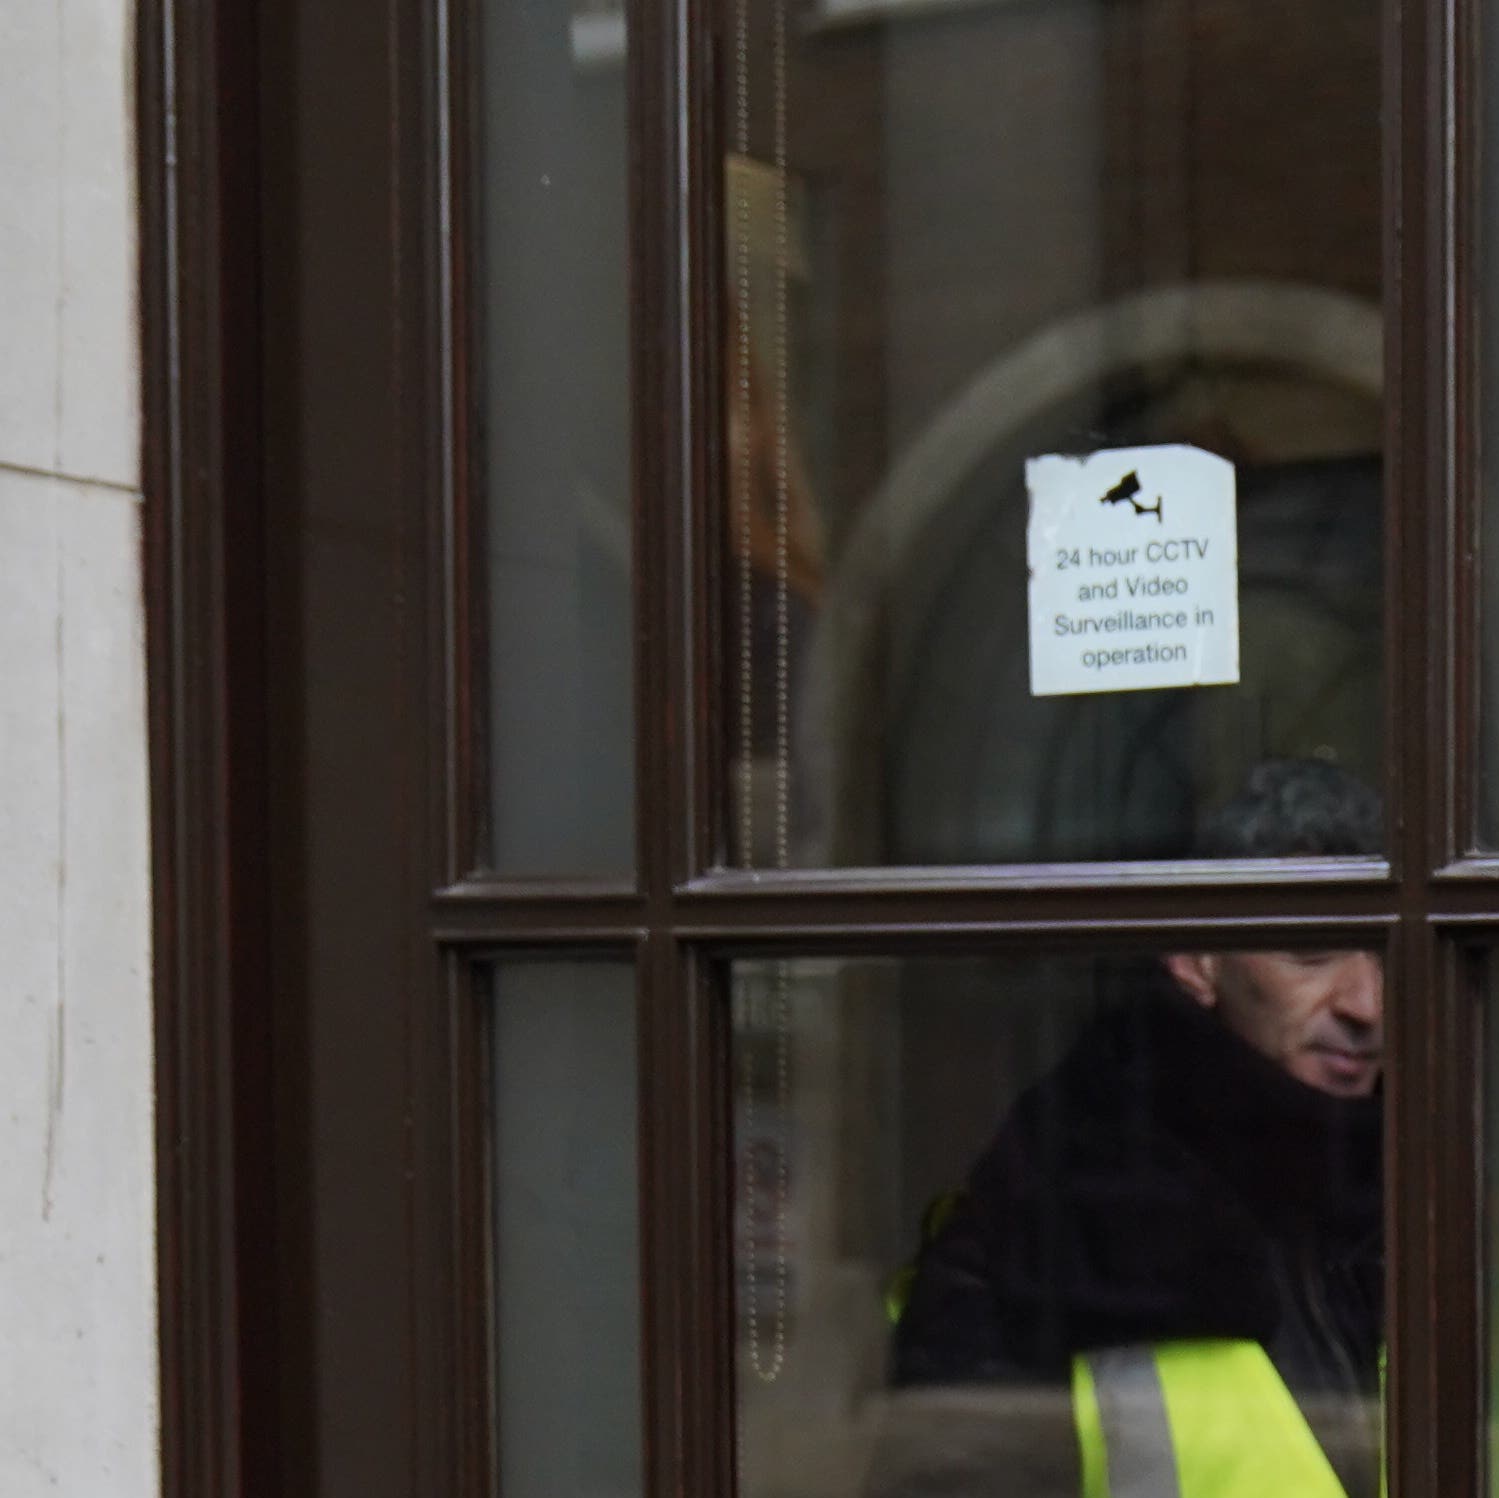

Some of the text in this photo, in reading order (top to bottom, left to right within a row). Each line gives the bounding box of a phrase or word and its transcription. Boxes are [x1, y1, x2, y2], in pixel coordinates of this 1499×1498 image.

[1057, 539, 1209, 569] 24 hour CCTV
[1078, 575, 1189, 601] and Video
[1054, 605, 1214, 636] Surveillance in
[1082, 643, 1187, 669] operation
